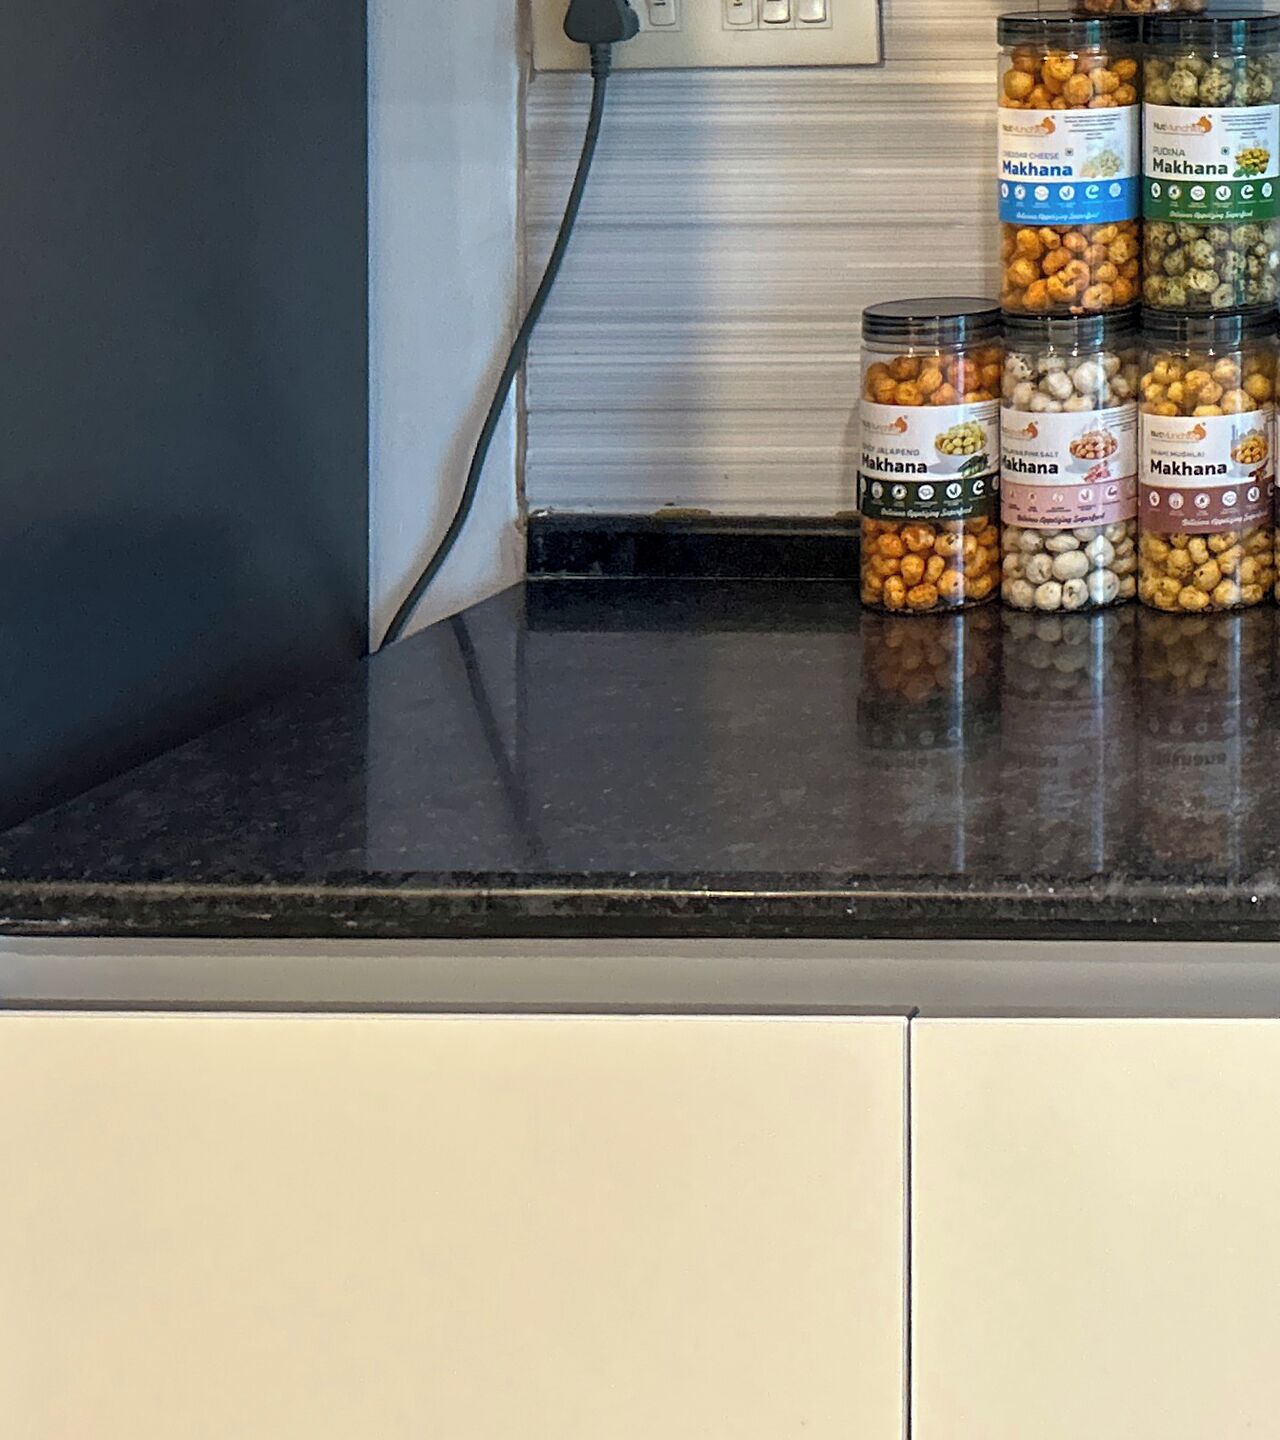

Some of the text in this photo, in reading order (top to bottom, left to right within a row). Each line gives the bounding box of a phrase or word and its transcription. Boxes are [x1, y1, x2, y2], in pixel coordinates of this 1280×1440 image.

[1003, 160, 1073, 176] Makhana
[1153, 158, 1228, 175] Makhana
[1040, 450, 1059, 458] SALT
[862, 453, 927, 473] Makhana
[1150, 459, 1227, 475] Makhana
